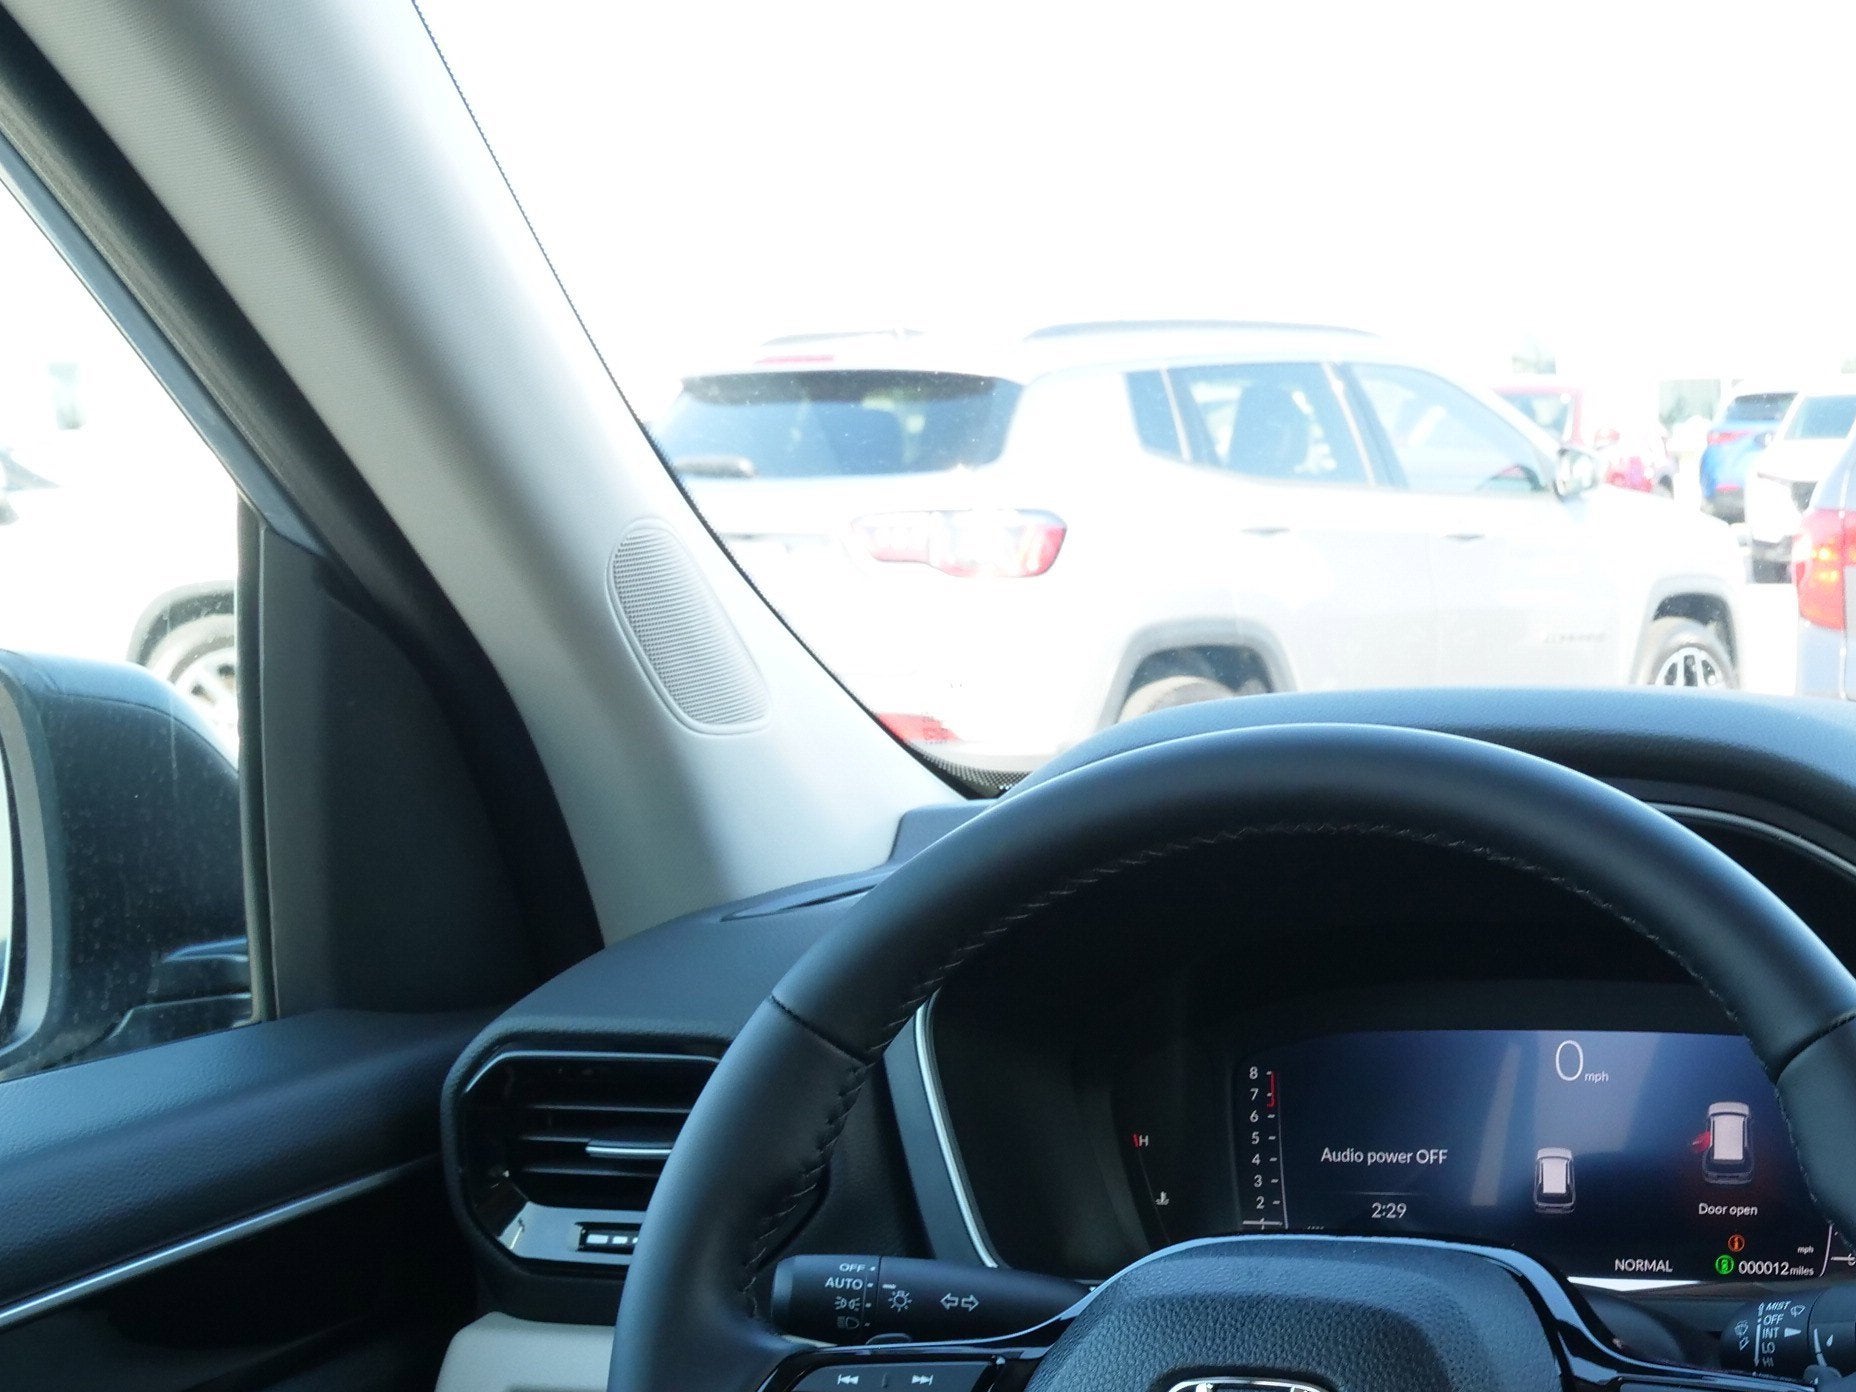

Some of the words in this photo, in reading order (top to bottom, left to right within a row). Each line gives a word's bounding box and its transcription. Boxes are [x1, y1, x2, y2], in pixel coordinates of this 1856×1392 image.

[1555, 1040, 1585, 1082] 0
[1585, 1070, 1609, 1084] mph
[1249, 1067, 1259, 1080] 8
[1250, 1089, 1259, 1101] 7
[1250, 1110, 1259, 1123] 6
[1139, 1135, 1149, 1147] H
[1251, 1132, 1260, 1145] 5
[1252, 1153, 1261, 1166] 4
[1321, 1147, 1364, 1163] Audio
[1367, 1150, 1413, 1165] power
[1416, 1149, 1448, 1165] OFF
[1254, 1175, 1263, 1187] 3
[1256, 1196, 1265, 1209] 2
[1371, 1203, 1407, 1219] 2:29
[1698, 1203, 1727, 1216] Door
[1729, 1204, 1758, 1218] open
[839, 1263, 866, 1273] OFF
[1614, 1259, 1673, 1273] NORMAL
[1738, 1260, 1789, 1276] 000012
[1789, 1265, 1815, 1276] miles
[825, 1277, 863, 1291] AUTO
[1765, 1300, 1791, 1311] MIST
[1763, 1313, 1785, 1326] OFF
[1762, 1327, 1779, 1339] INT
[1762, 1341, 1776, 1354] LO
